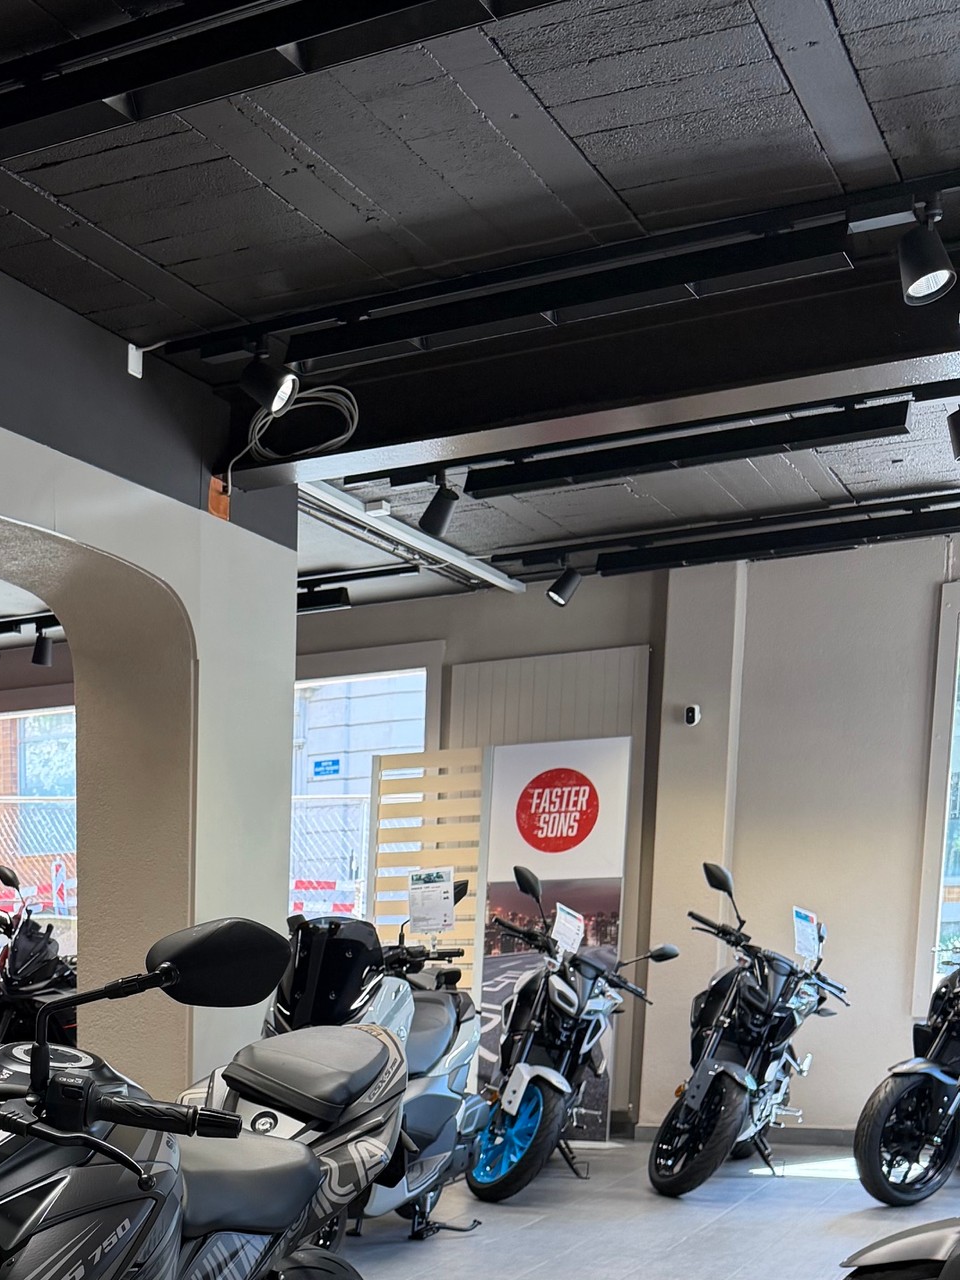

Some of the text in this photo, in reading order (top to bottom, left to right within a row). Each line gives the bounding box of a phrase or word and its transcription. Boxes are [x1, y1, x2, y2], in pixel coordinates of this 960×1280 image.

[530, 786, 589, 814] FASTER
[538, 811, 580, 838] SONS
[87, 1217, 131, 1265] 750
